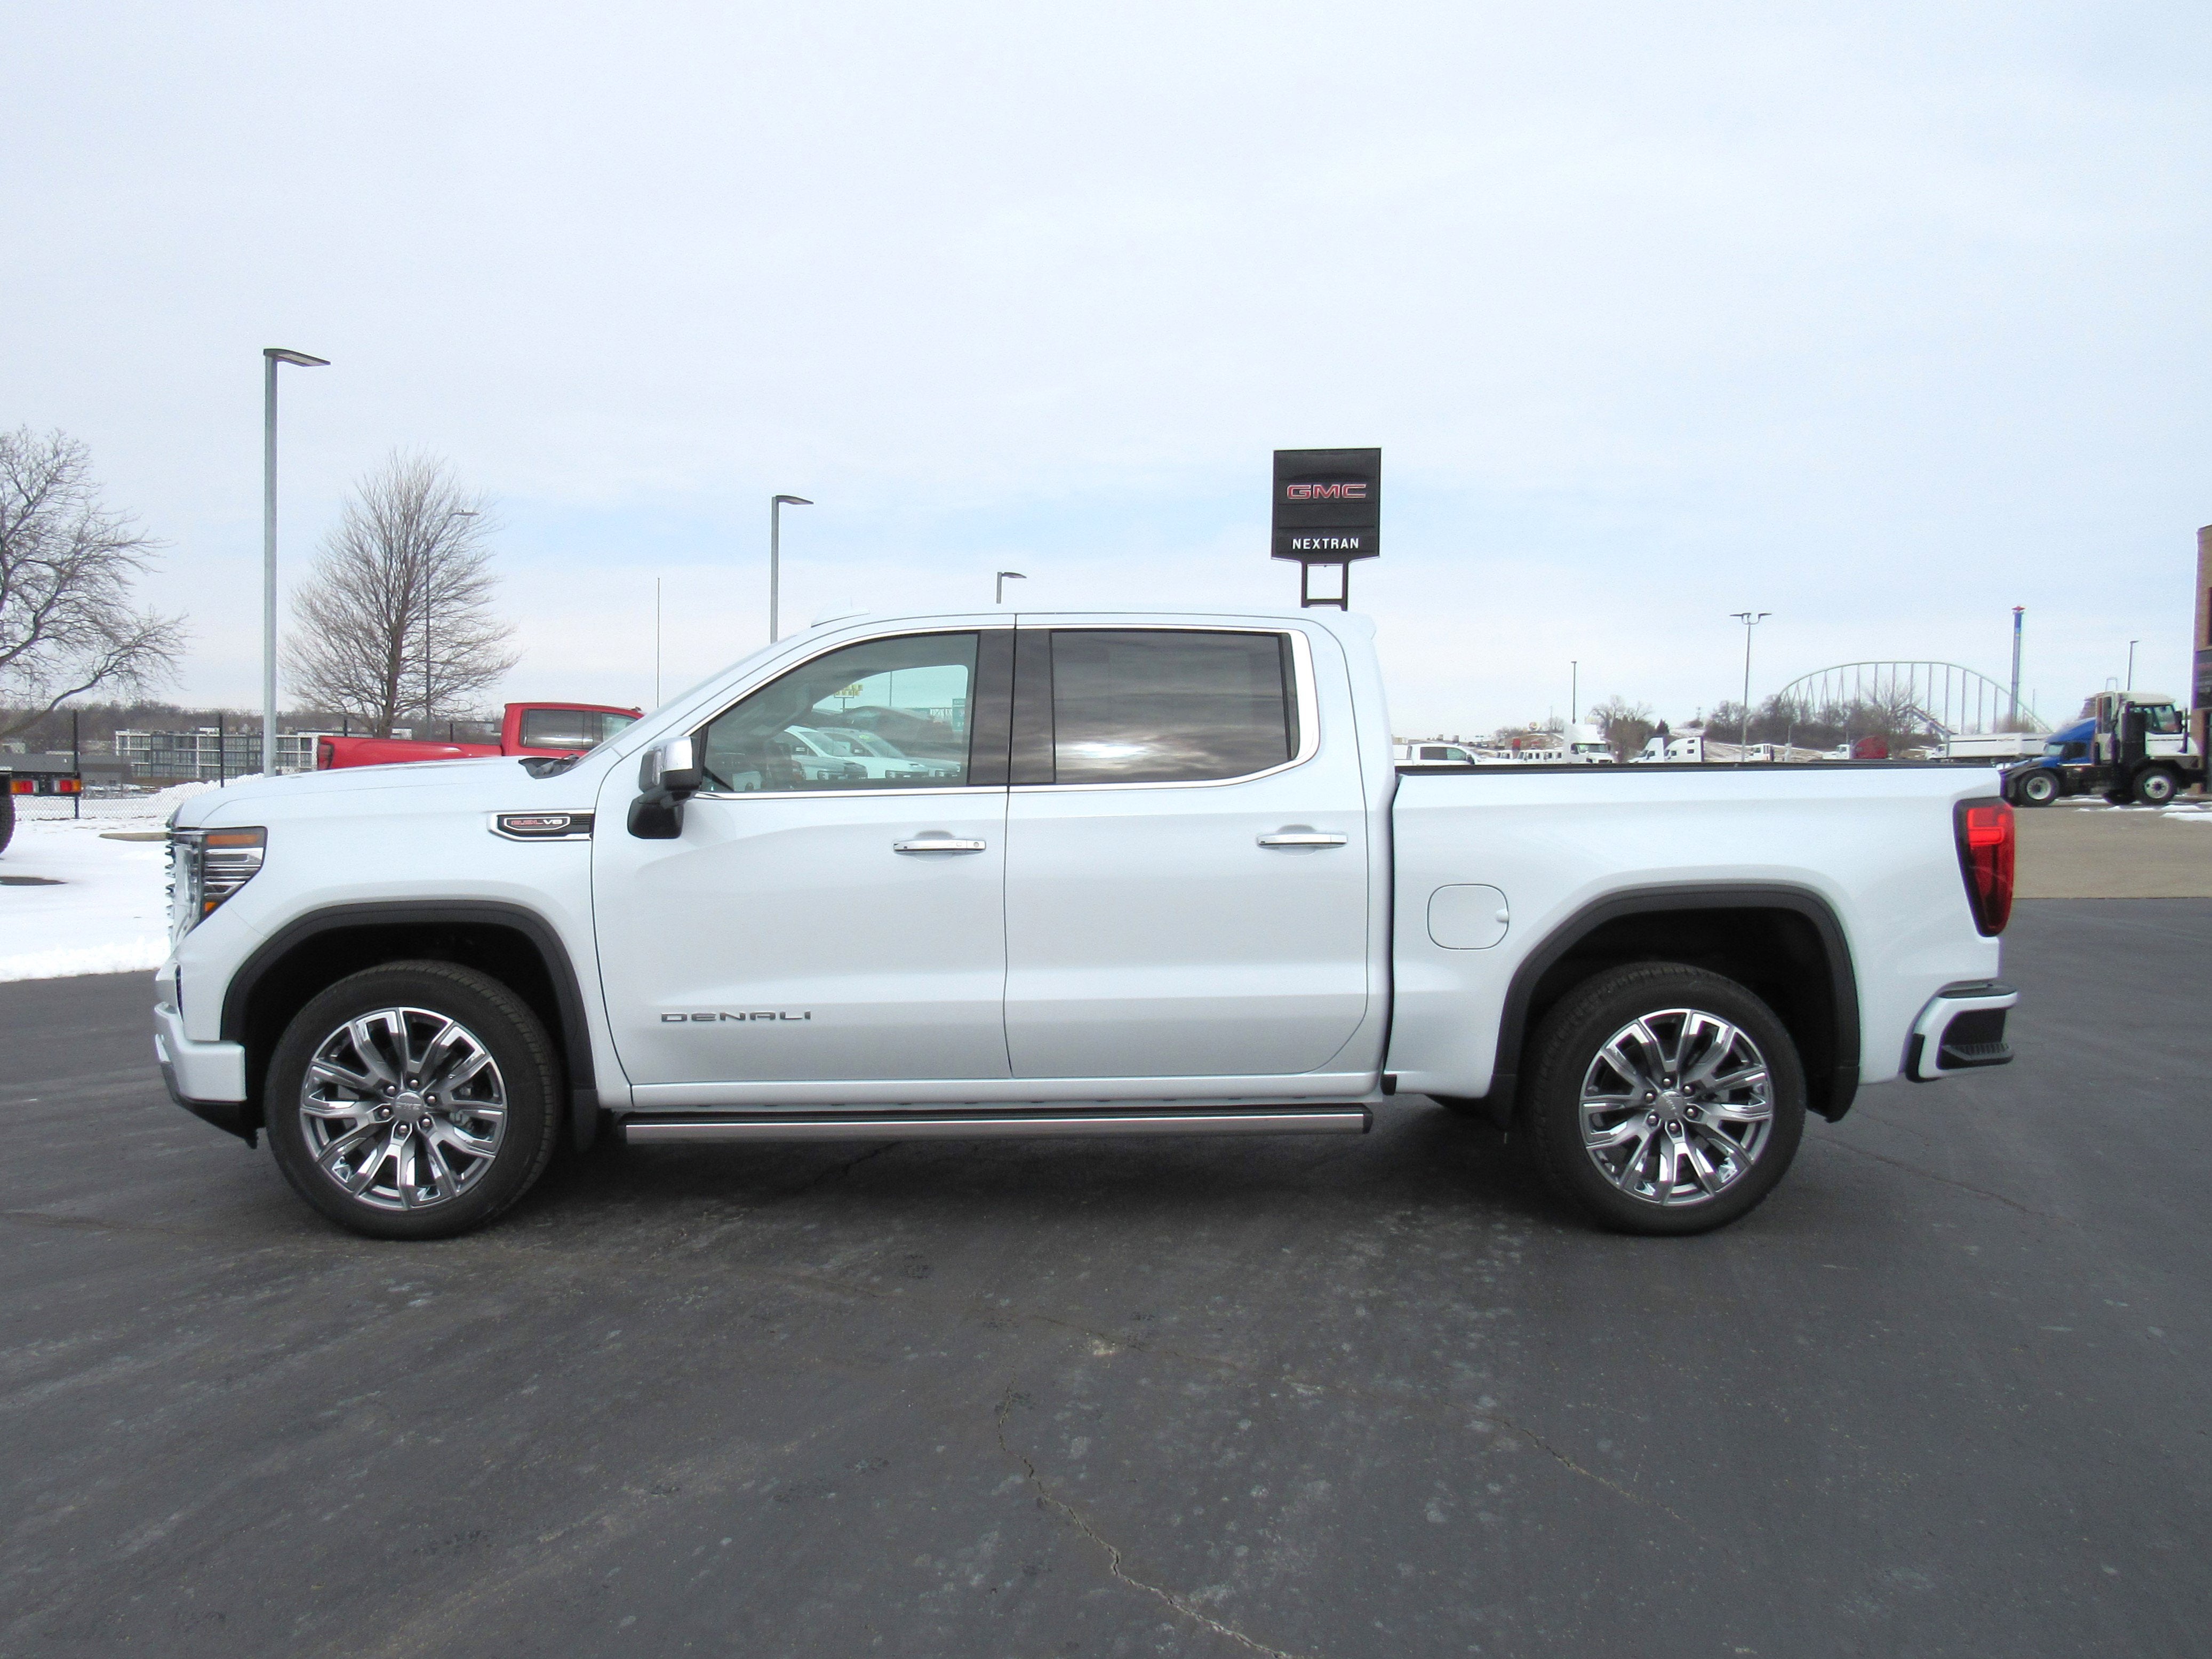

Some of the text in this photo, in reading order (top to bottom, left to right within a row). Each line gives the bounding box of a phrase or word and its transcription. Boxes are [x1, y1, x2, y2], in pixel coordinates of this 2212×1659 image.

[1287, 484, 1366, 499] GMC
[1292, 538, 1359, 549] NEXTRAN
[661, 1010, 811, 1022] DENALI
